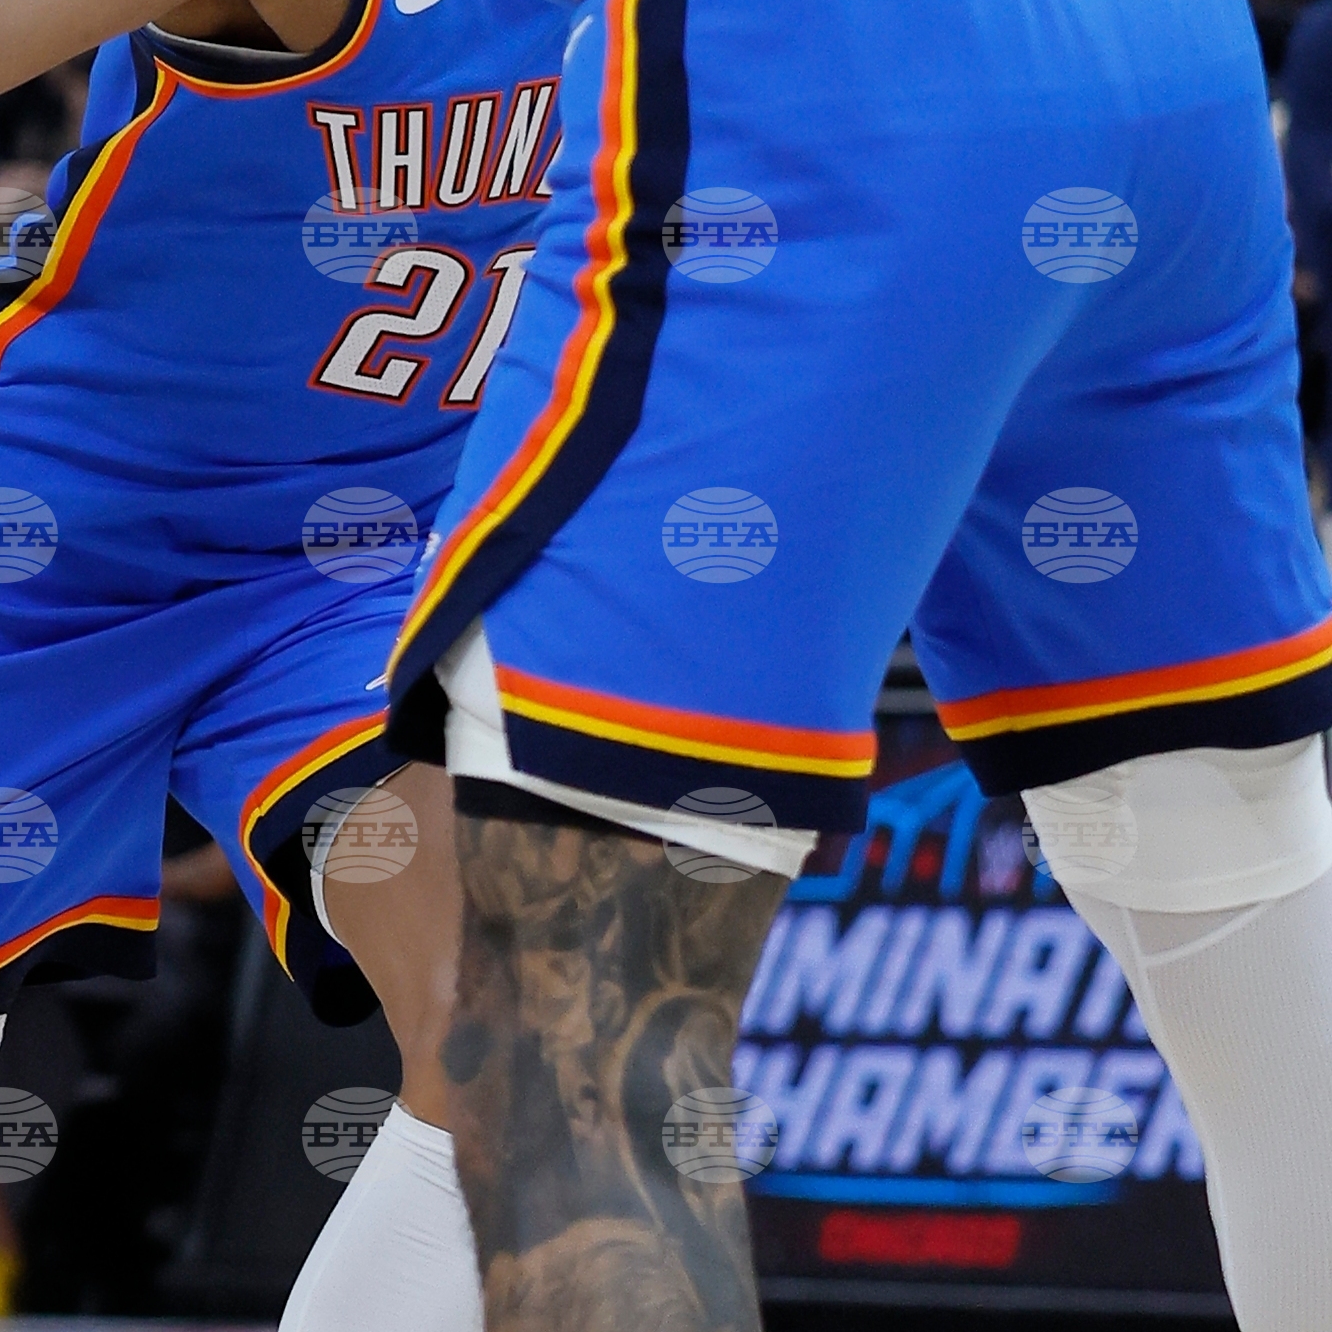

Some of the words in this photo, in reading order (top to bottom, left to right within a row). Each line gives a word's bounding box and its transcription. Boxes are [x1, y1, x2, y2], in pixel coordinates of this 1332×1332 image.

[307, 75, 564, 217] THUN
[308, 243, 537, 411] 21
[730, 1041, 1206, 1182] HAMBER
